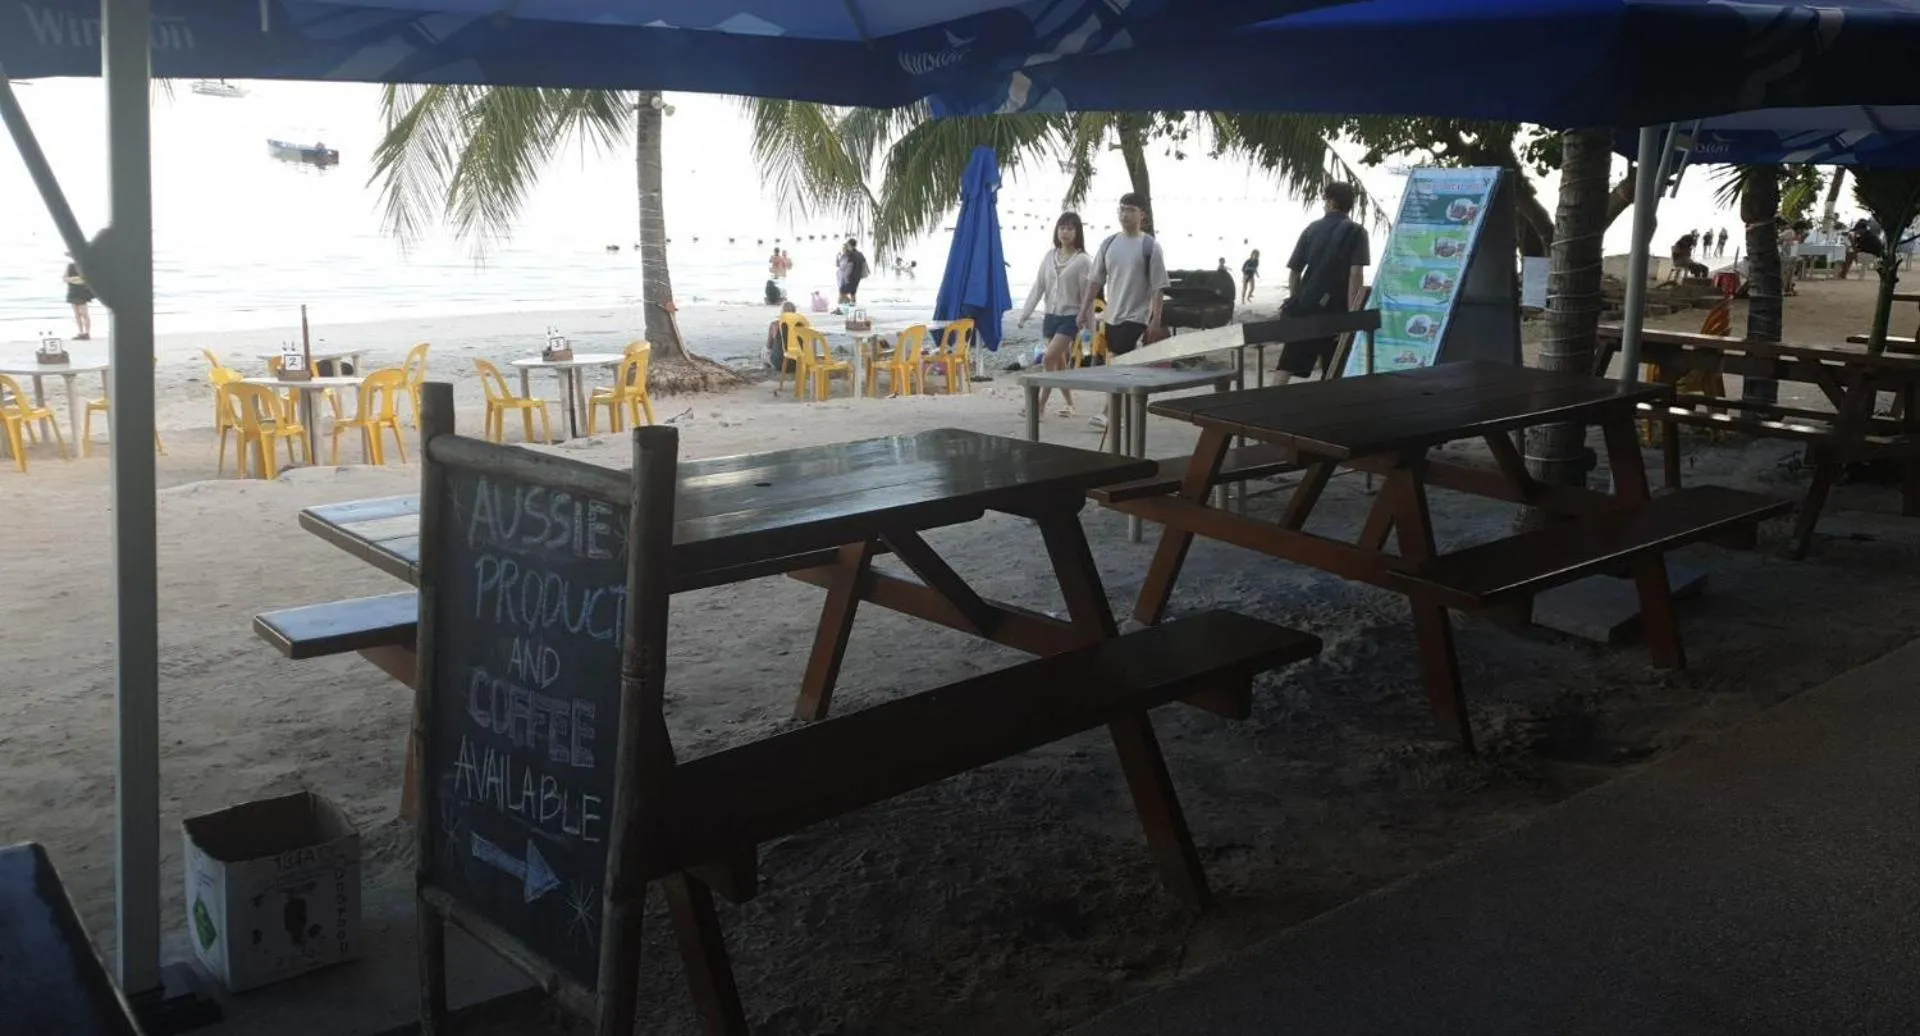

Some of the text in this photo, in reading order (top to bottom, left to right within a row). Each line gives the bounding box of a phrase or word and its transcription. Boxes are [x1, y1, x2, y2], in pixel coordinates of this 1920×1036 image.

[22, 3, 195, 49] Winon
[469, 476, 613, 560] AUSSIE
[474, 554, 628, 650] PRODUCT
[507, 636, 561, 690] AND
[467, 668, 597, 769] COFFEE
[453, 734, 602, 843] AVAILABLE
